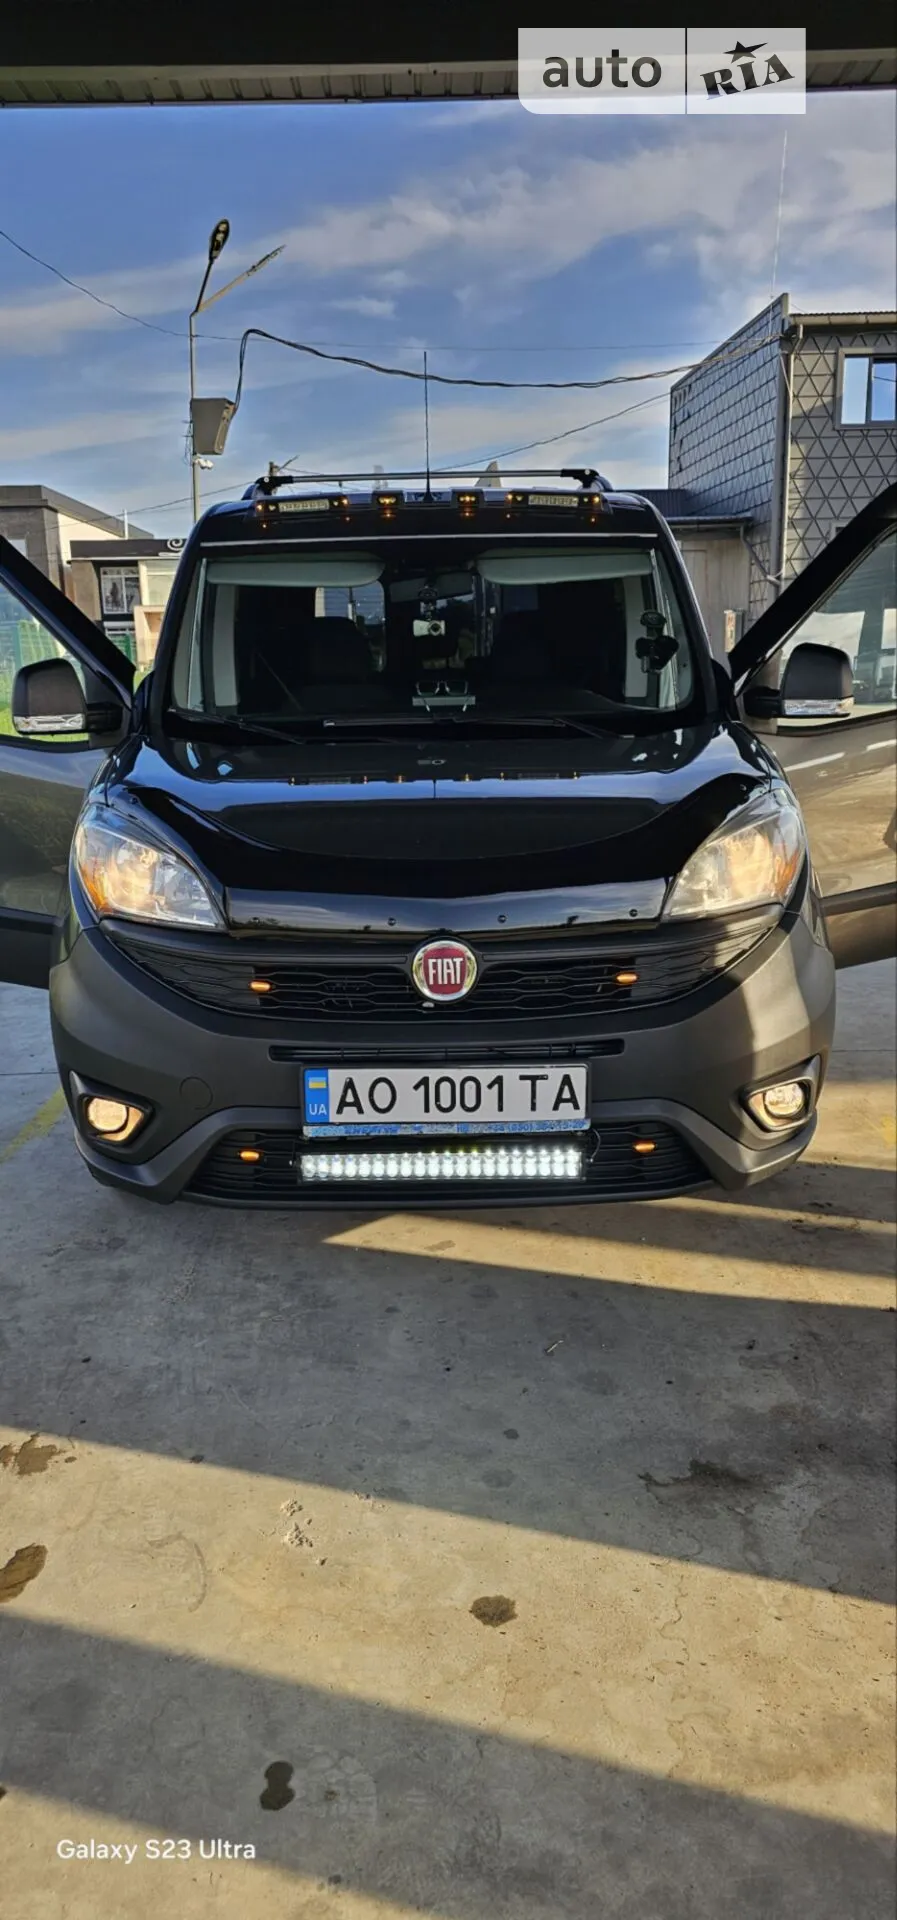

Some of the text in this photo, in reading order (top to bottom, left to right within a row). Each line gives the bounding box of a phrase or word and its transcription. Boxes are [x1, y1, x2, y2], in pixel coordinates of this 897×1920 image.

[427, 957, 464, 985] FIAT
[336, 1073, 581, 1115] AO 1001 TA
[309, 1103, 327, 1116] UA
